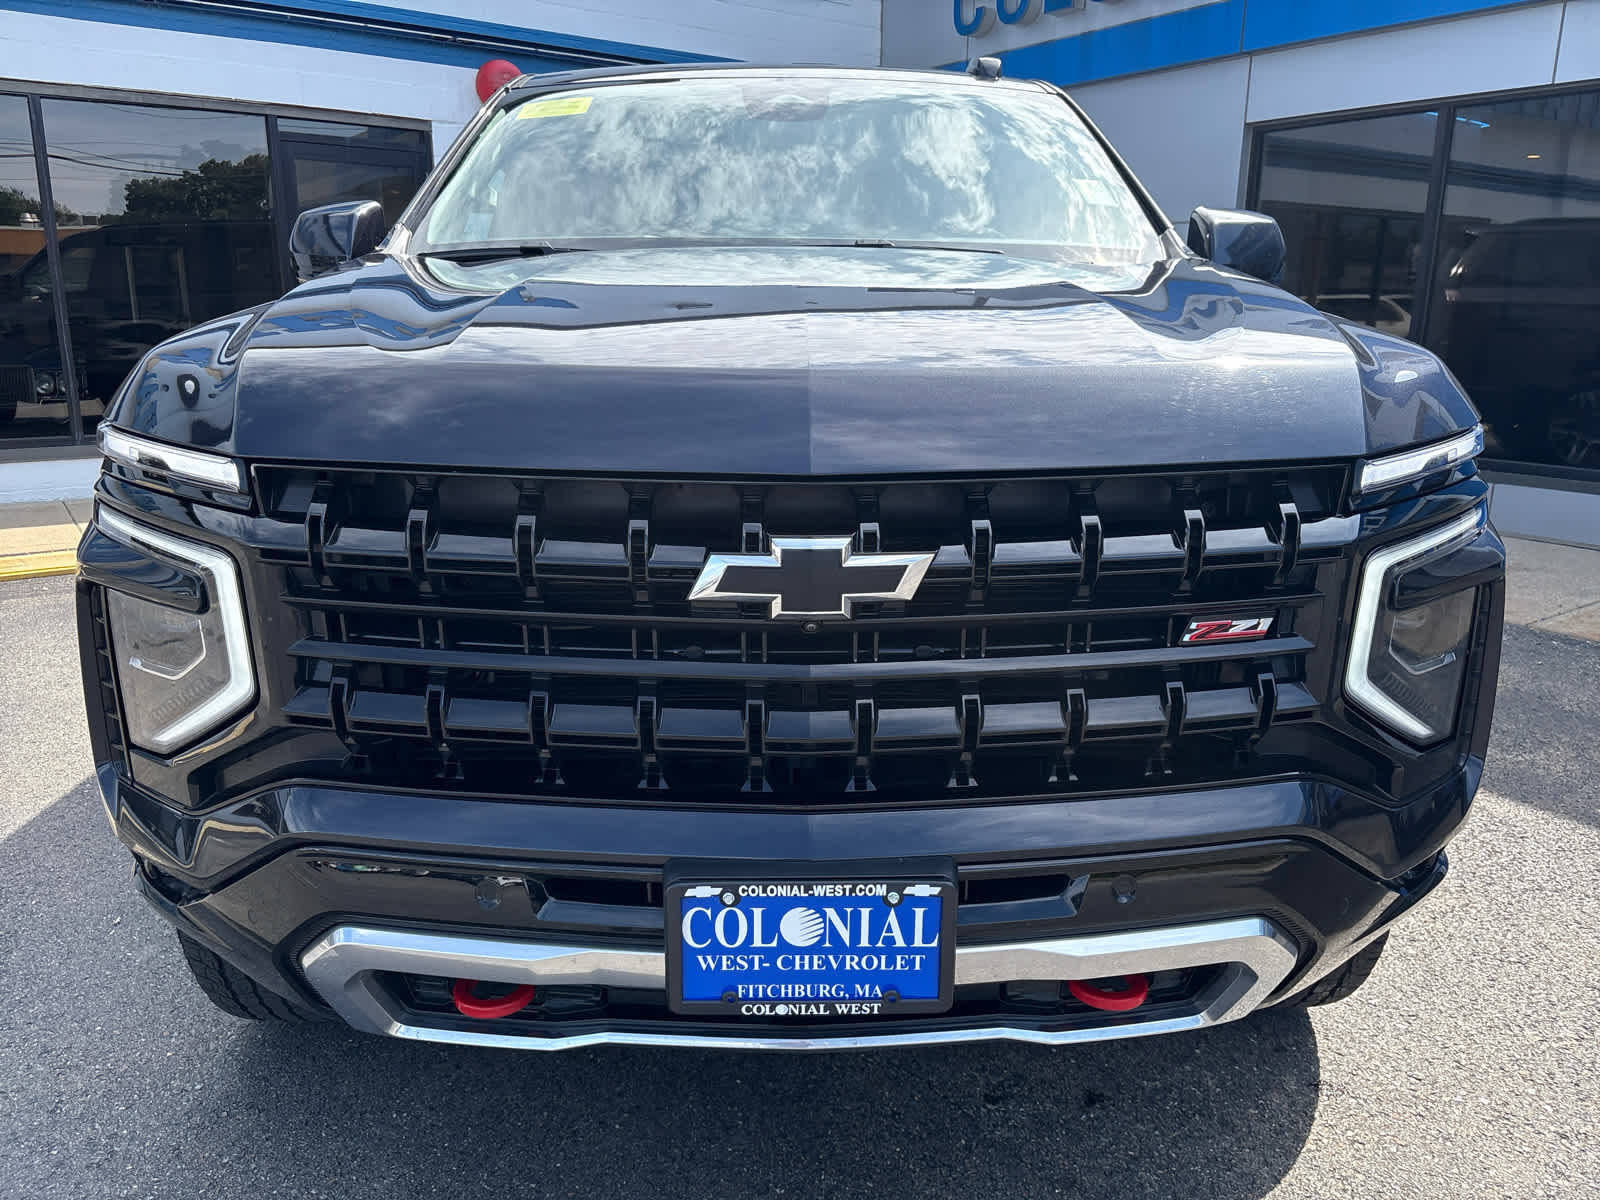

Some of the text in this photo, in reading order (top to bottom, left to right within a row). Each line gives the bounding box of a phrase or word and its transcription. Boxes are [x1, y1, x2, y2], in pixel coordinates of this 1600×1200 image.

[1183, 617, 1274, 641] Z71
[738, 884, 887, 897] COLONIAL-WEST.COM
[682, 906, 938, 949] COLONIAL
[776, 954, 925, 972] CHEVROLET
[737, 983, 883, 1000] FITCHBURG, MA
[741, 1003, 882, 1016] COLONIAL WEST
